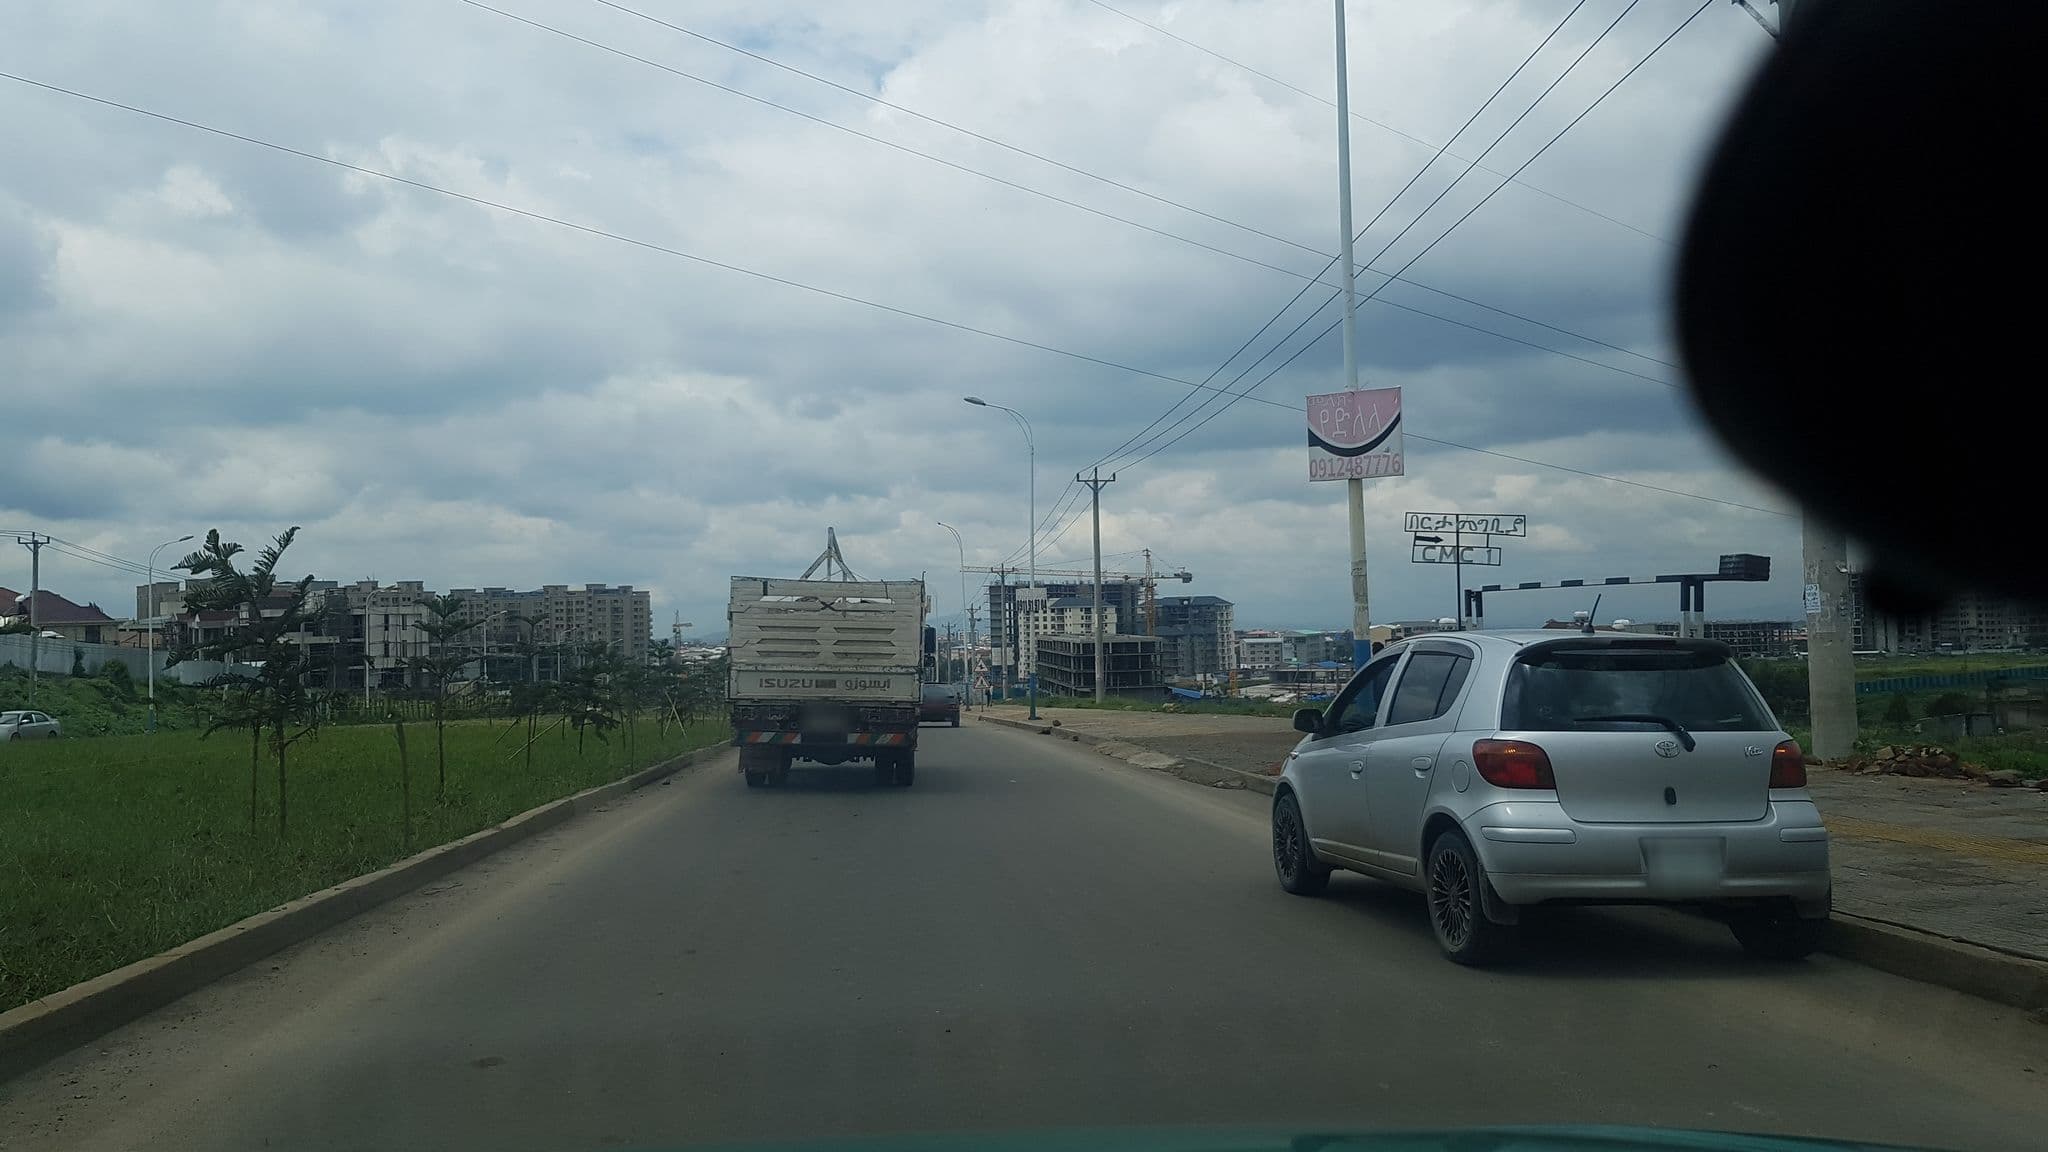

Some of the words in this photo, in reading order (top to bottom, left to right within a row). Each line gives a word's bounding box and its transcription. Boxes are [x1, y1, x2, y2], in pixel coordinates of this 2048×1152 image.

[1309, 453, 1401, 478] 0912487776
[1409, 515, 1453, 531] በርታ
[1422, 546, 1474, 563] CMC
[759, 678, 813, 689] ISUZU
